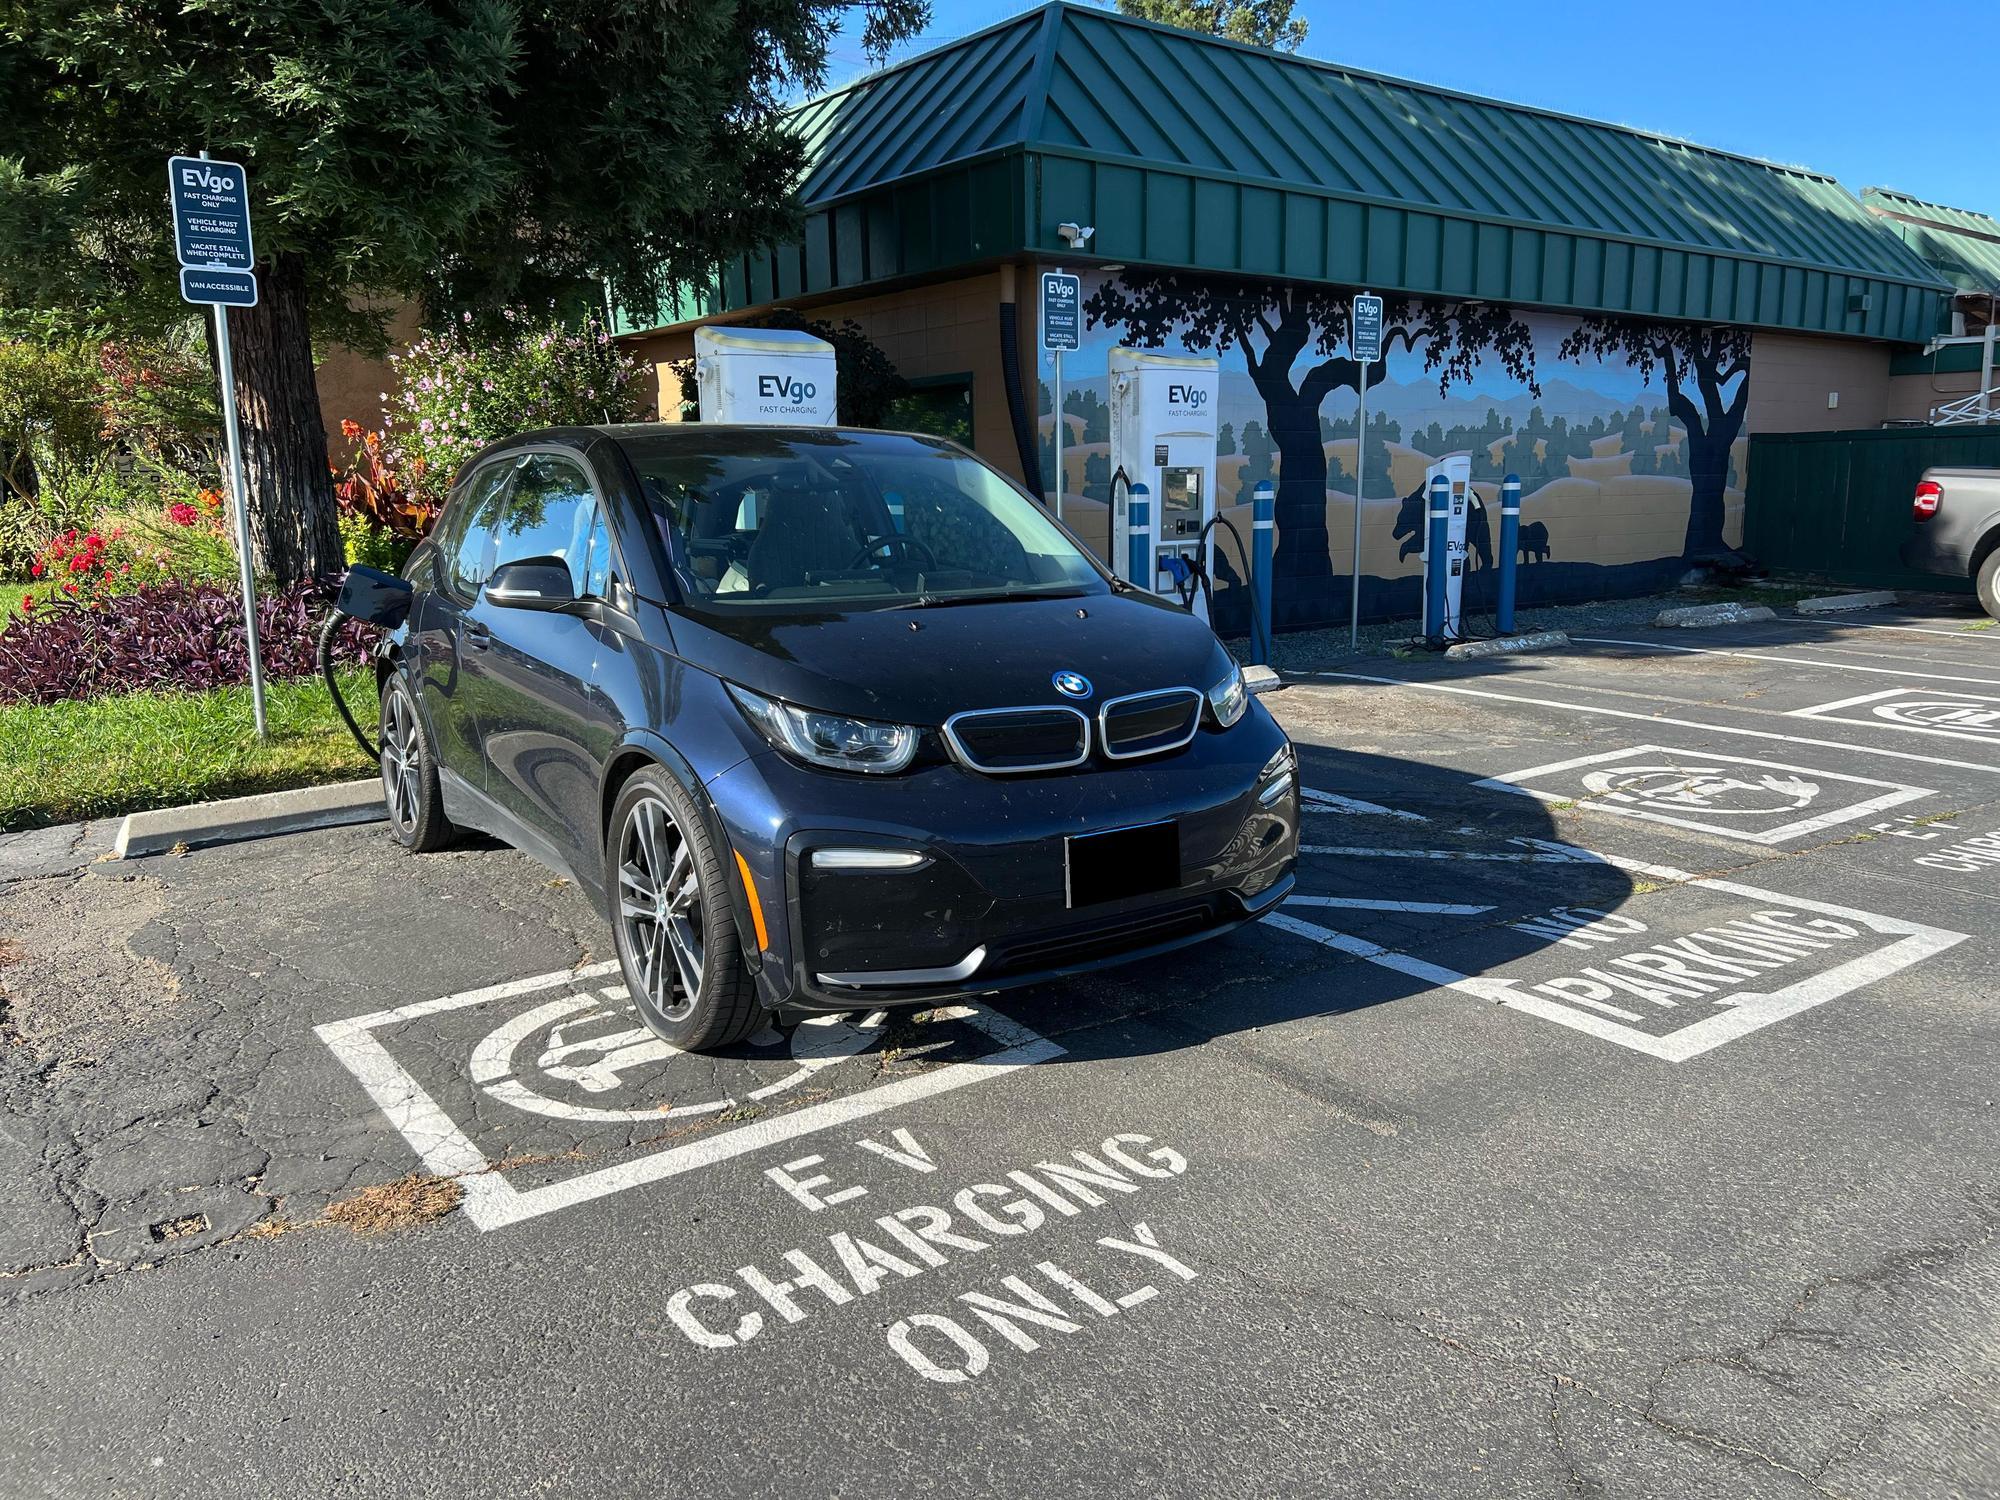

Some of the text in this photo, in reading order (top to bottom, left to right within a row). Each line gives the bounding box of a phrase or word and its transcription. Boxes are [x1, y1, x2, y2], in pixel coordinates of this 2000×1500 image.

[182, 167, 235, 193] EVgo
[184, 192, 236, 203] FAST CHARGING
[187, 218, 217, 226] VEHICLE
[200, 226, 236, 234] CHARGING
[190, 243, 218, 251] VACATE
[209, 251, 245, 260] COMPLETE
[206, 283, 249, 292] ACCESSIBLE
[1048, 279, 1074, 298] EVgo
[1358, 300, 1378, 316] EVgo
[758, 375, 816, 404] EVgo
[1169, 385, 1207, 408] EVgo
[780, 406, 817, 414] CHARGING
[1504, 906, 1648, 950] NO
[1532, 910, 1859, 1022] PARKING
[666, 1133, 1188, 1348] CHARGING
[887, 1221, 1199, 1383] ONLY
